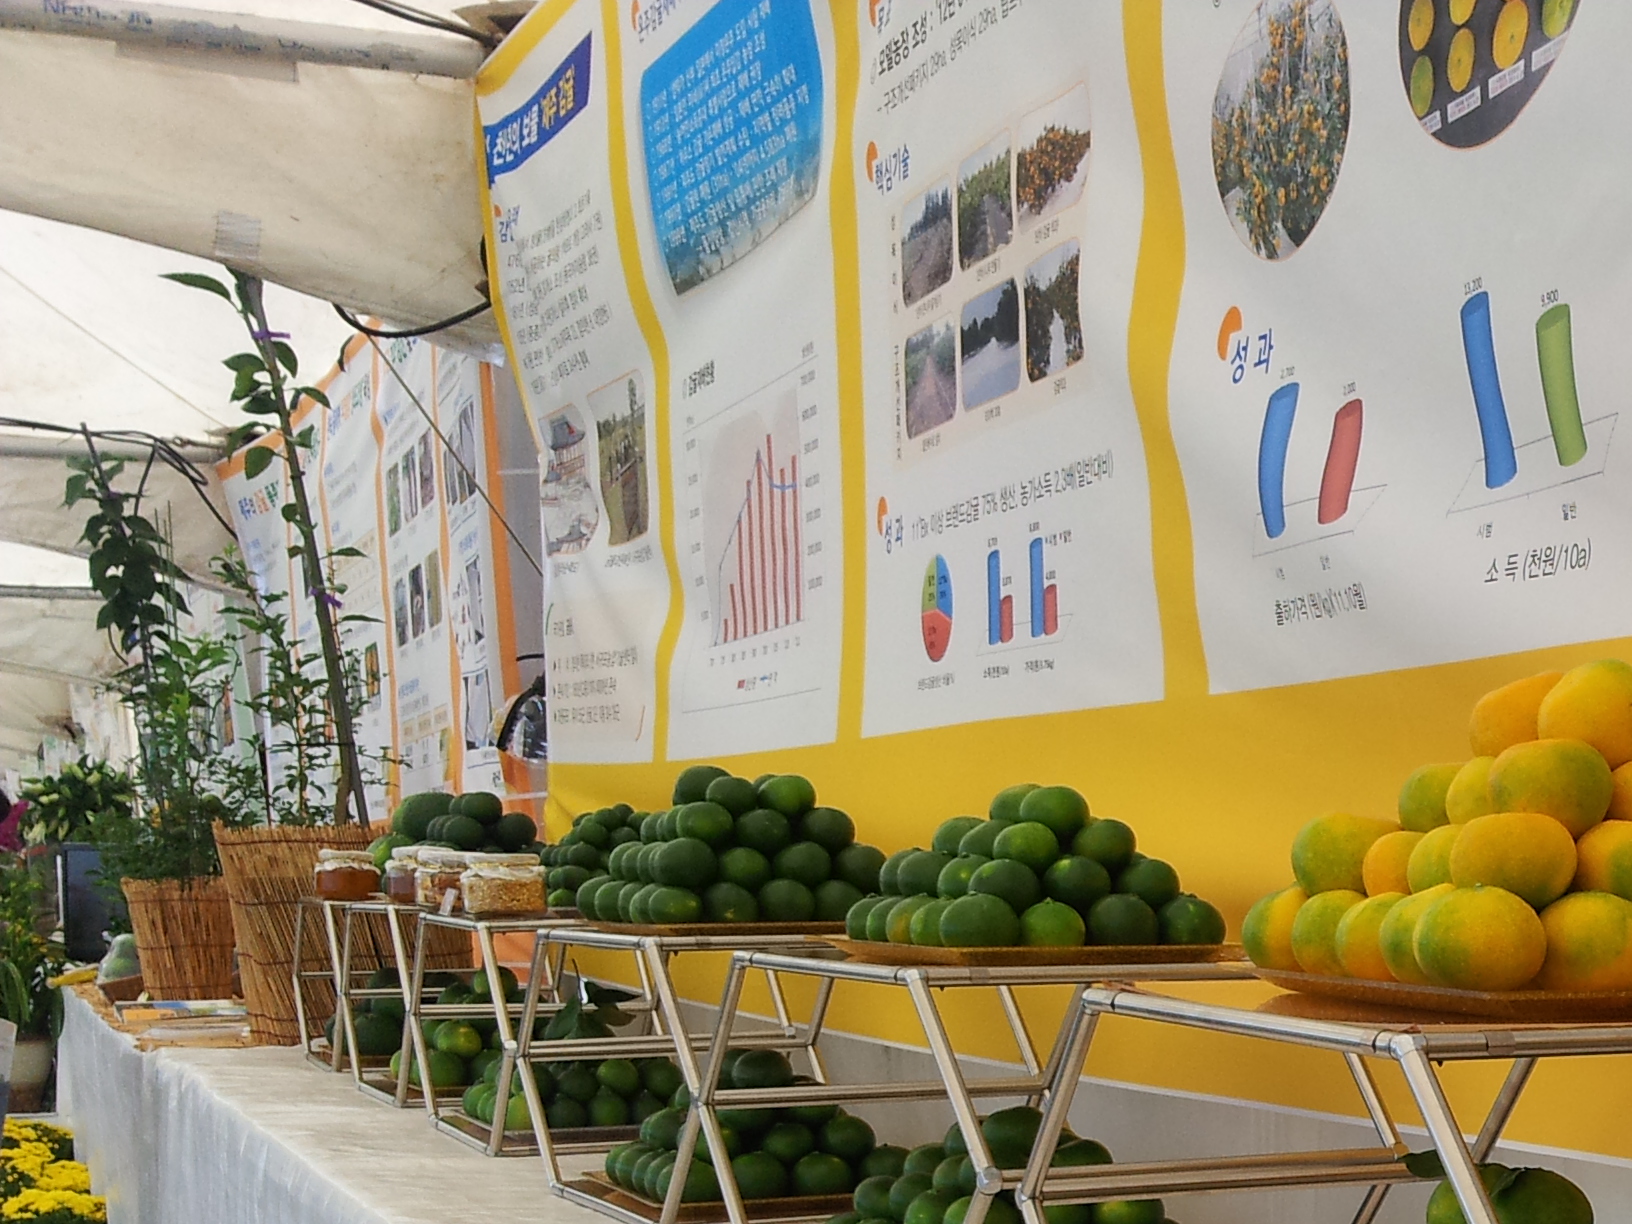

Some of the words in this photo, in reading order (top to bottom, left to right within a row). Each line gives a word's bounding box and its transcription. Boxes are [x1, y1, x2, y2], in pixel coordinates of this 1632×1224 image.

[522, 103, 539, 147] 보물
[540, 86, 557, 130] 제주
[558, 64, 575, 117] 감귤
[874, 143, 910, 196] 핵심기술
